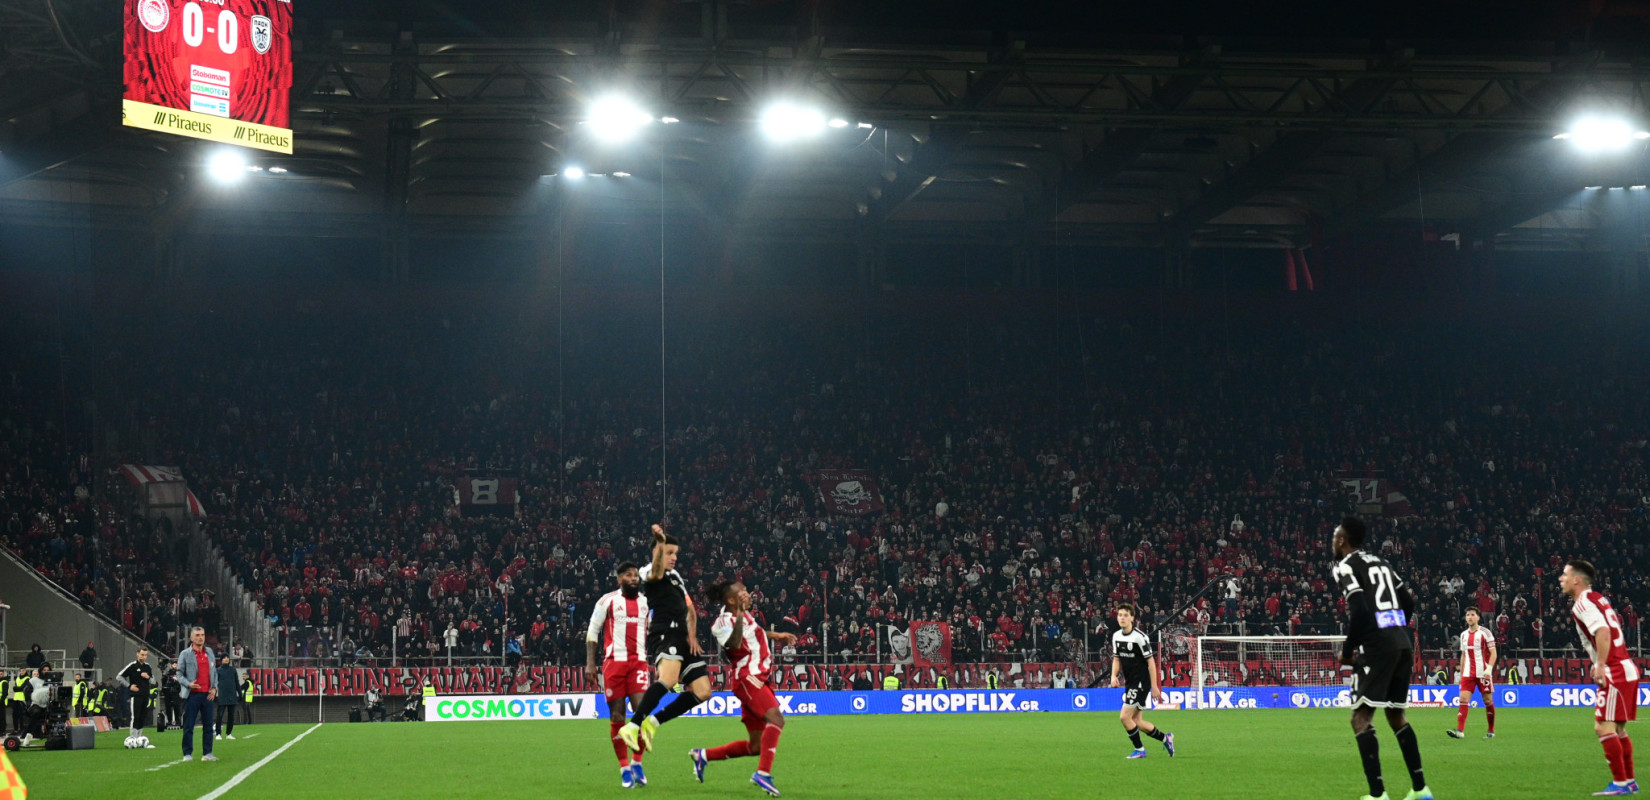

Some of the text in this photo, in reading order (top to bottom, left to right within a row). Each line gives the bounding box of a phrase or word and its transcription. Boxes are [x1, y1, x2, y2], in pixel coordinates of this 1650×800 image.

[168, 113, 212, 134] Piraeus
[247, 128, 289, 148] Piraeus
[471, 479, 499, 504] 8
[1368, 566, 1399, 610] 21
[636, 670, 649, 684] 23
[437, 698, 583, 718] COSMOTE TV
